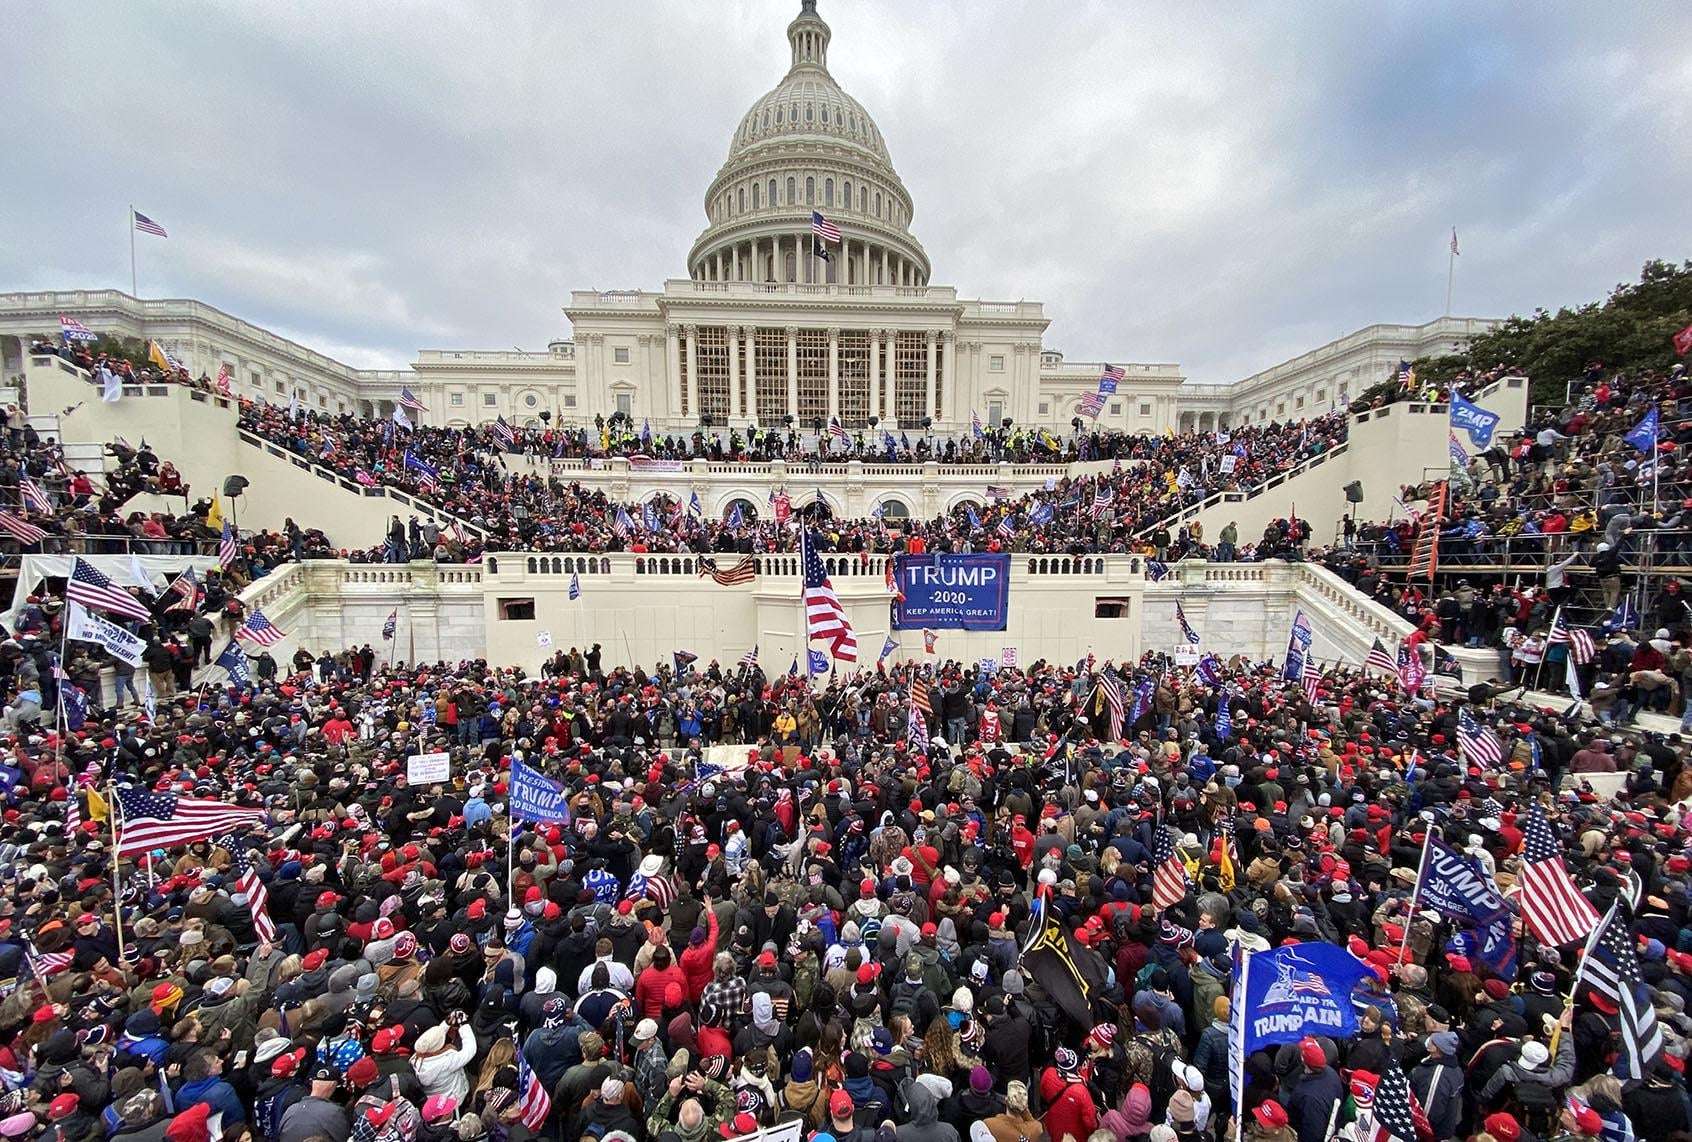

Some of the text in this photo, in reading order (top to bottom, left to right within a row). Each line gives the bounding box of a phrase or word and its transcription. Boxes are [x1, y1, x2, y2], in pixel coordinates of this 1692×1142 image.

[906, 565, 997, 586] TRUMP
[906, 608, 927, 616] KEEP
[966, 608, 997, 617] GREAT!
[106, 641, 137, 661] BULLSHIT
[513, 781, 562, 809] TRUMP
[1430, 843, 1500, 910] RUMP
[1254, 1006, 1342, 1038] TRUMP AIN
